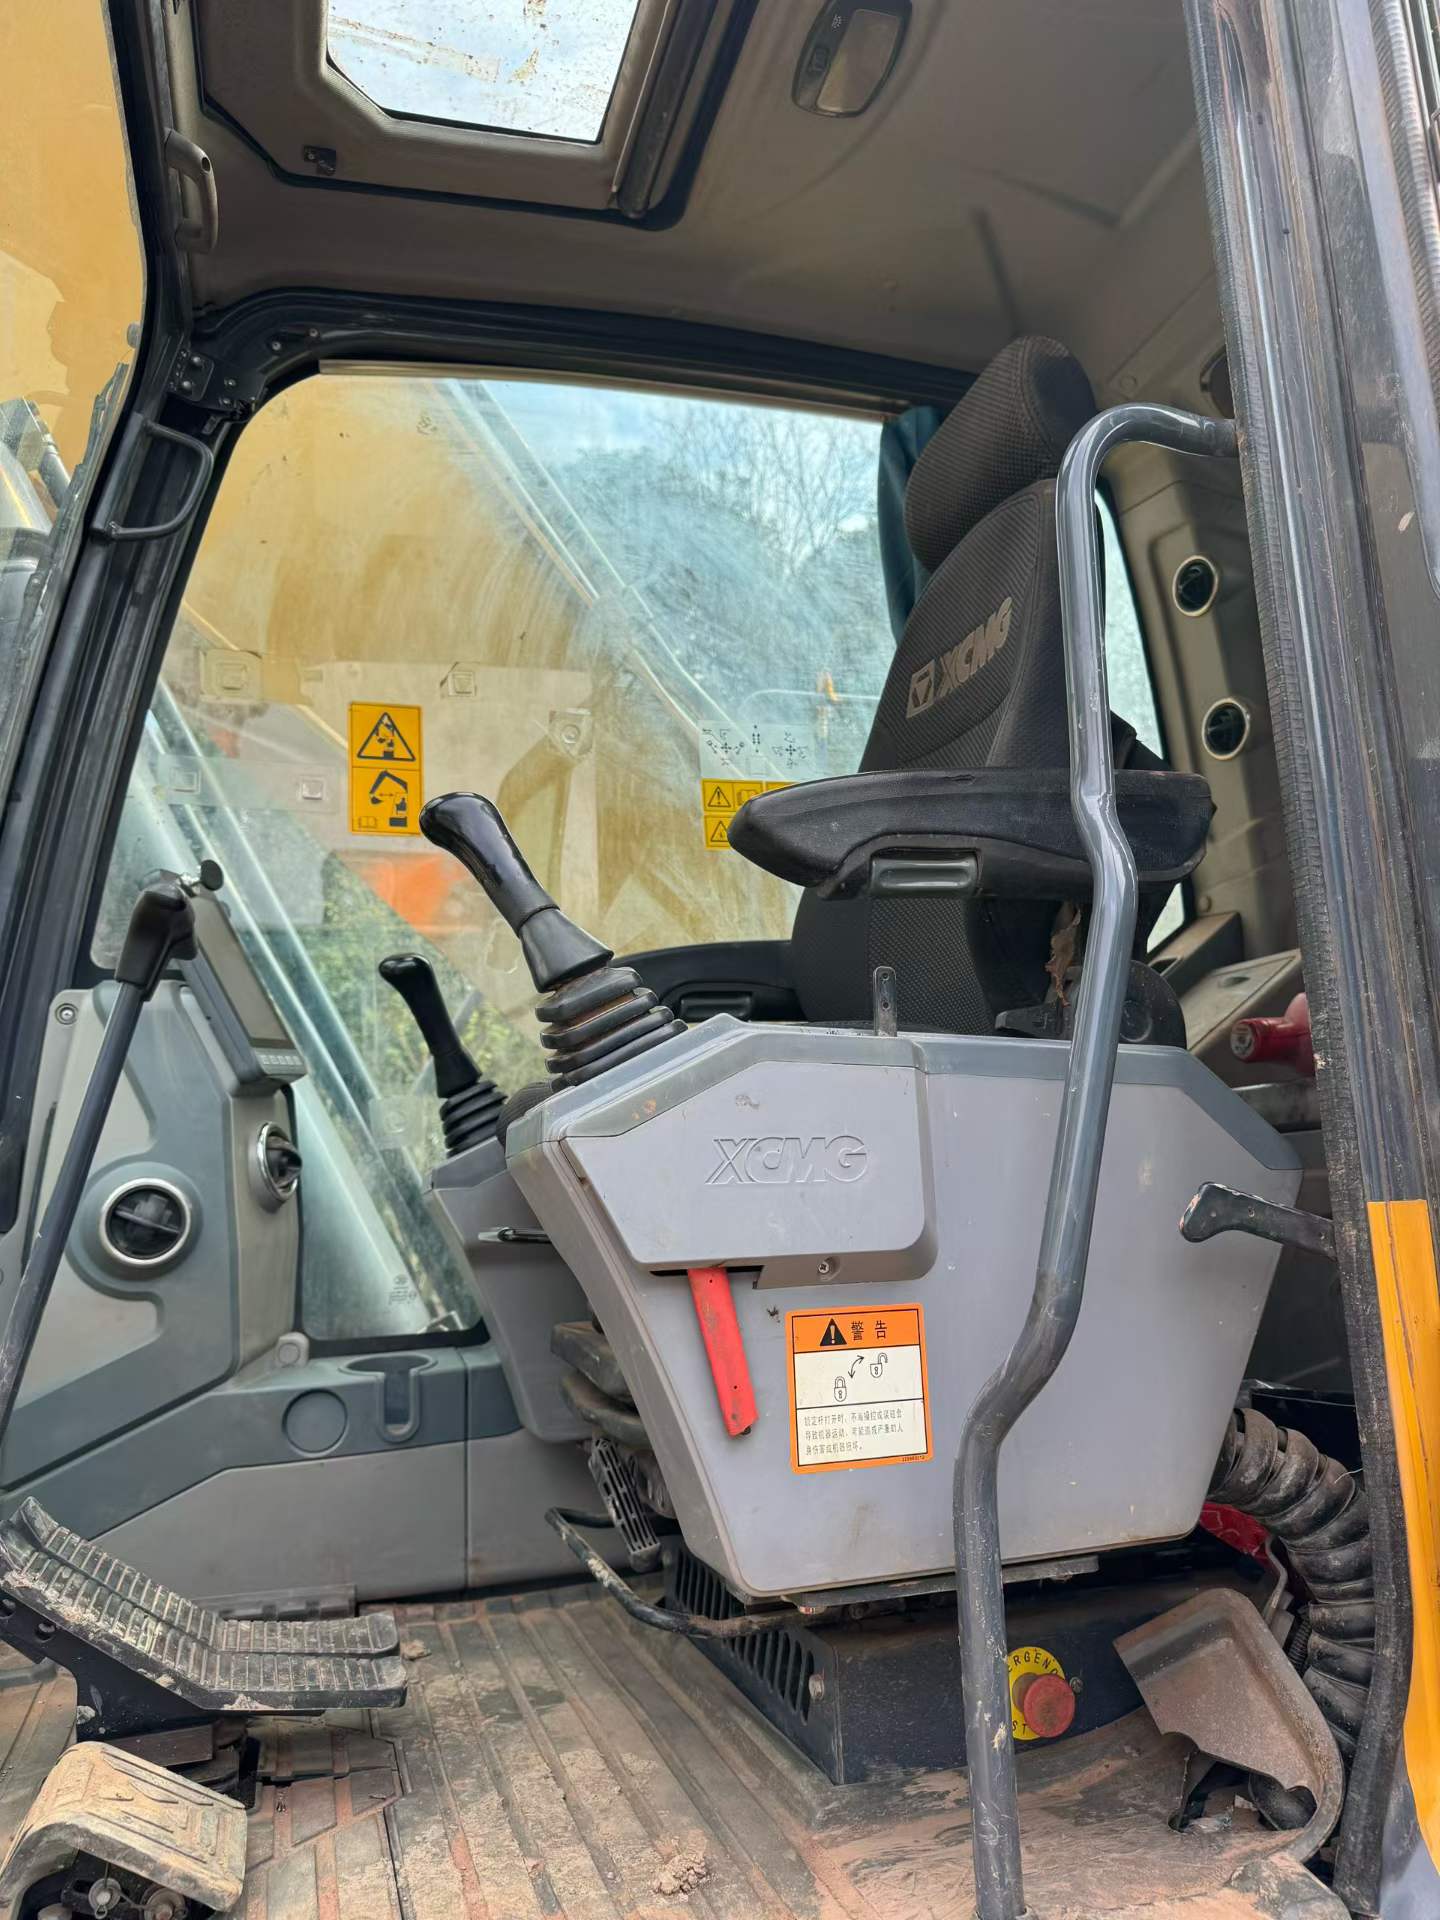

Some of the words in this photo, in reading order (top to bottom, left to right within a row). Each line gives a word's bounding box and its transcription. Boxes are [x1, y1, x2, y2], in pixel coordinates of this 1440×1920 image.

[936, 596, 1013, 699] XCMG
[704, 1135, 868, 1185] XCMG
[850, 1319, 888, 1341] 警告
